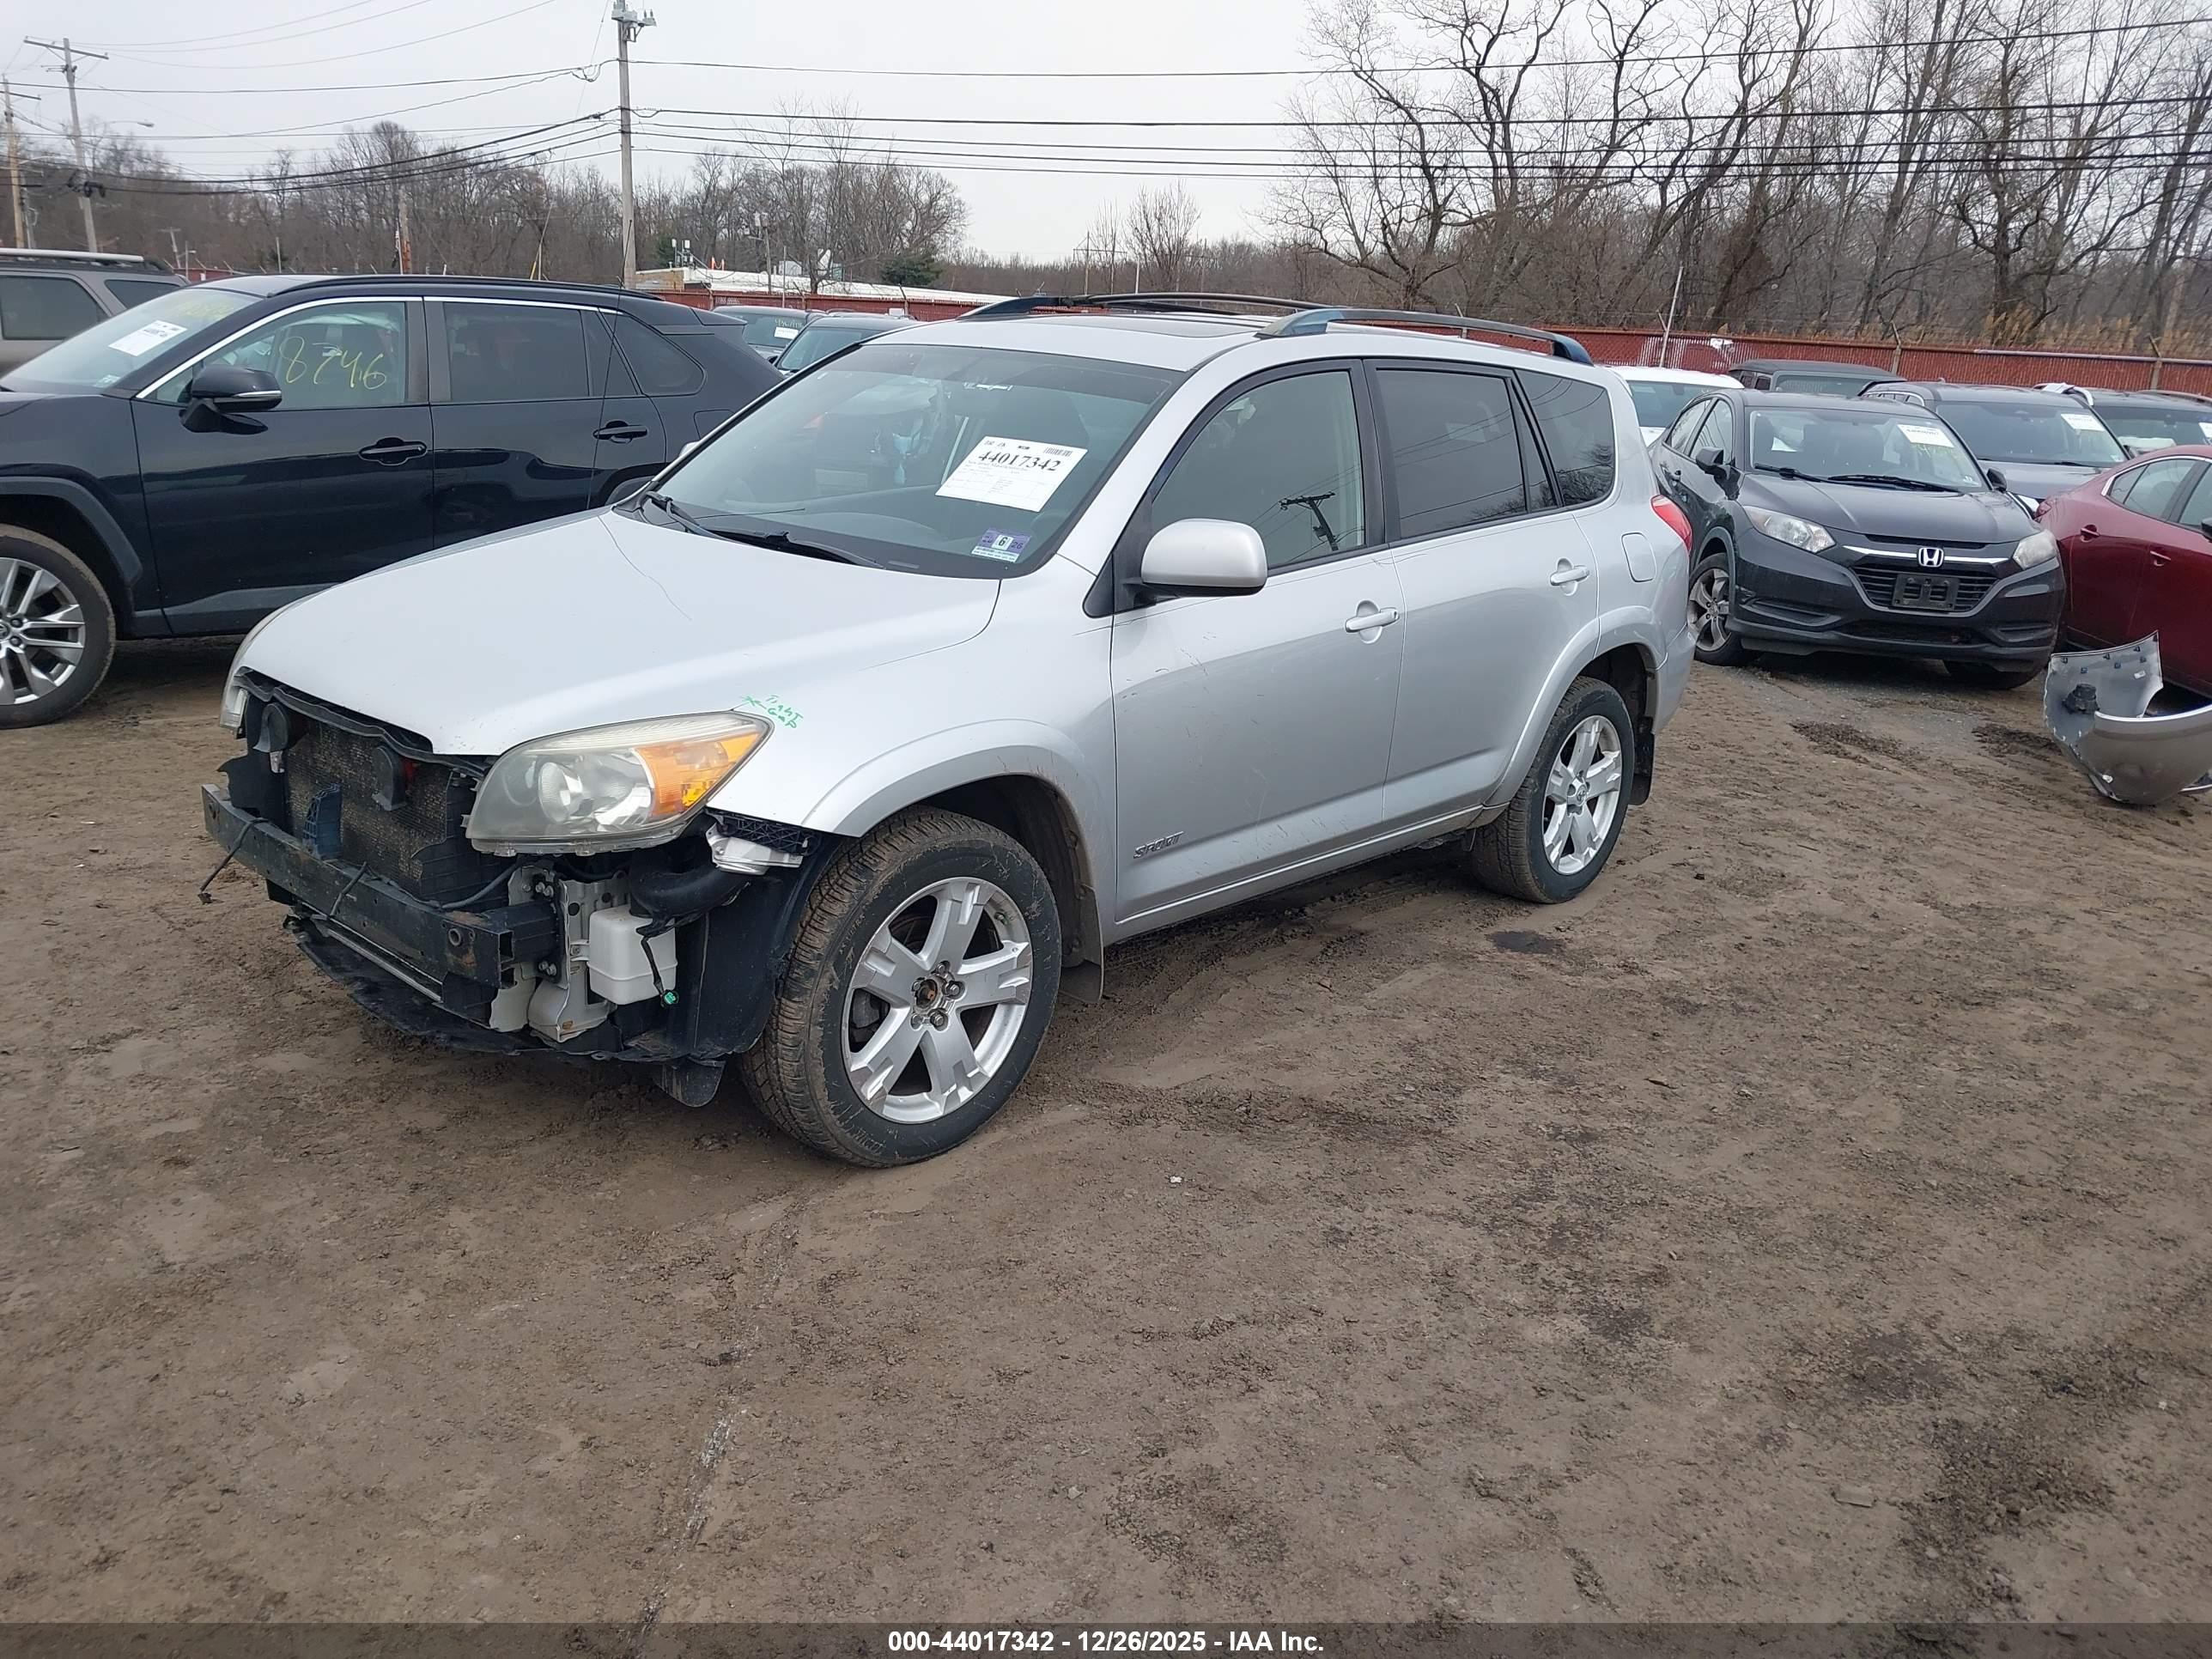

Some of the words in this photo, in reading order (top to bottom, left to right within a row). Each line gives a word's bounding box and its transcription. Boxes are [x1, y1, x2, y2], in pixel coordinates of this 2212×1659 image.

[278, 336, 386, 390] 8746
[978, 451, 1061, 471] 44017342
[998, 536, 1009, 547] 6
